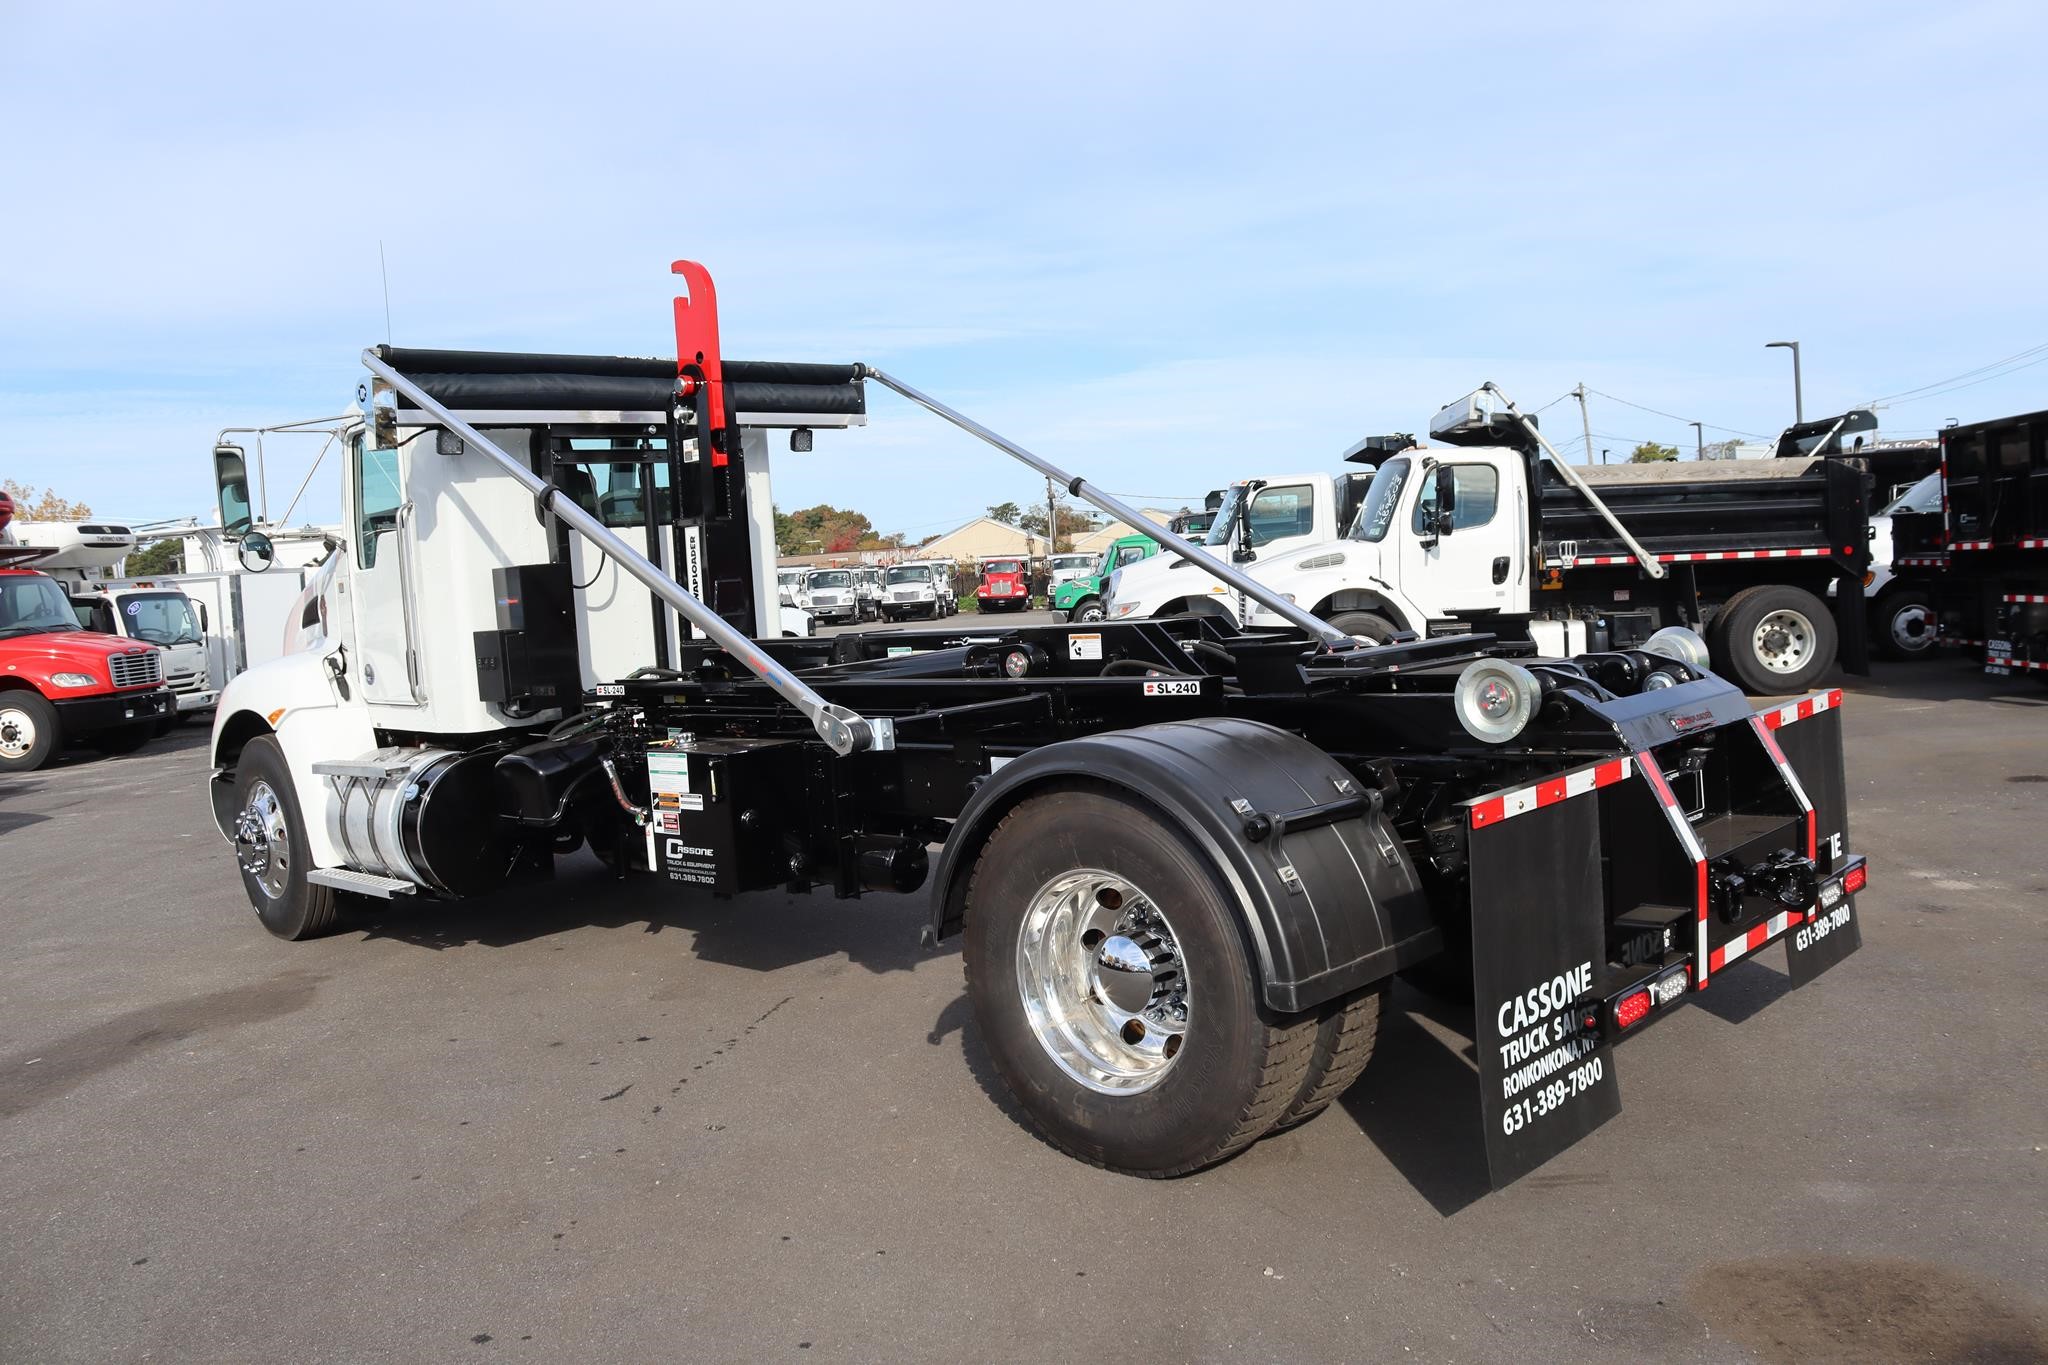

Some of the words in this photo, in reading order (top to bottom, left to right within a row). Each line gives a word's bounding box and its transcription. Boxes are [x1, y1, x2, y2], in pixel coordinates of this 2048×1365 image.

[689, 536, 700, 601] WAPLOADER
[603, 686, 624, 694] SL-240
[1157, 683, 1198, 694] SL-240
[666, 838, 714, 859] CASSONE
[687, 861, 716, 869] EQUIPMENT
[670, 872, 715, 884] 631.389.7800
[1796, 904, 1851, 951] 631-389-7800
[1498, 961, 1593, 1038] CASSONE
[1500, 1023, 1551, 1070] TRUCK
[1503, 1057, 1603, 1136] 631-389-7800
